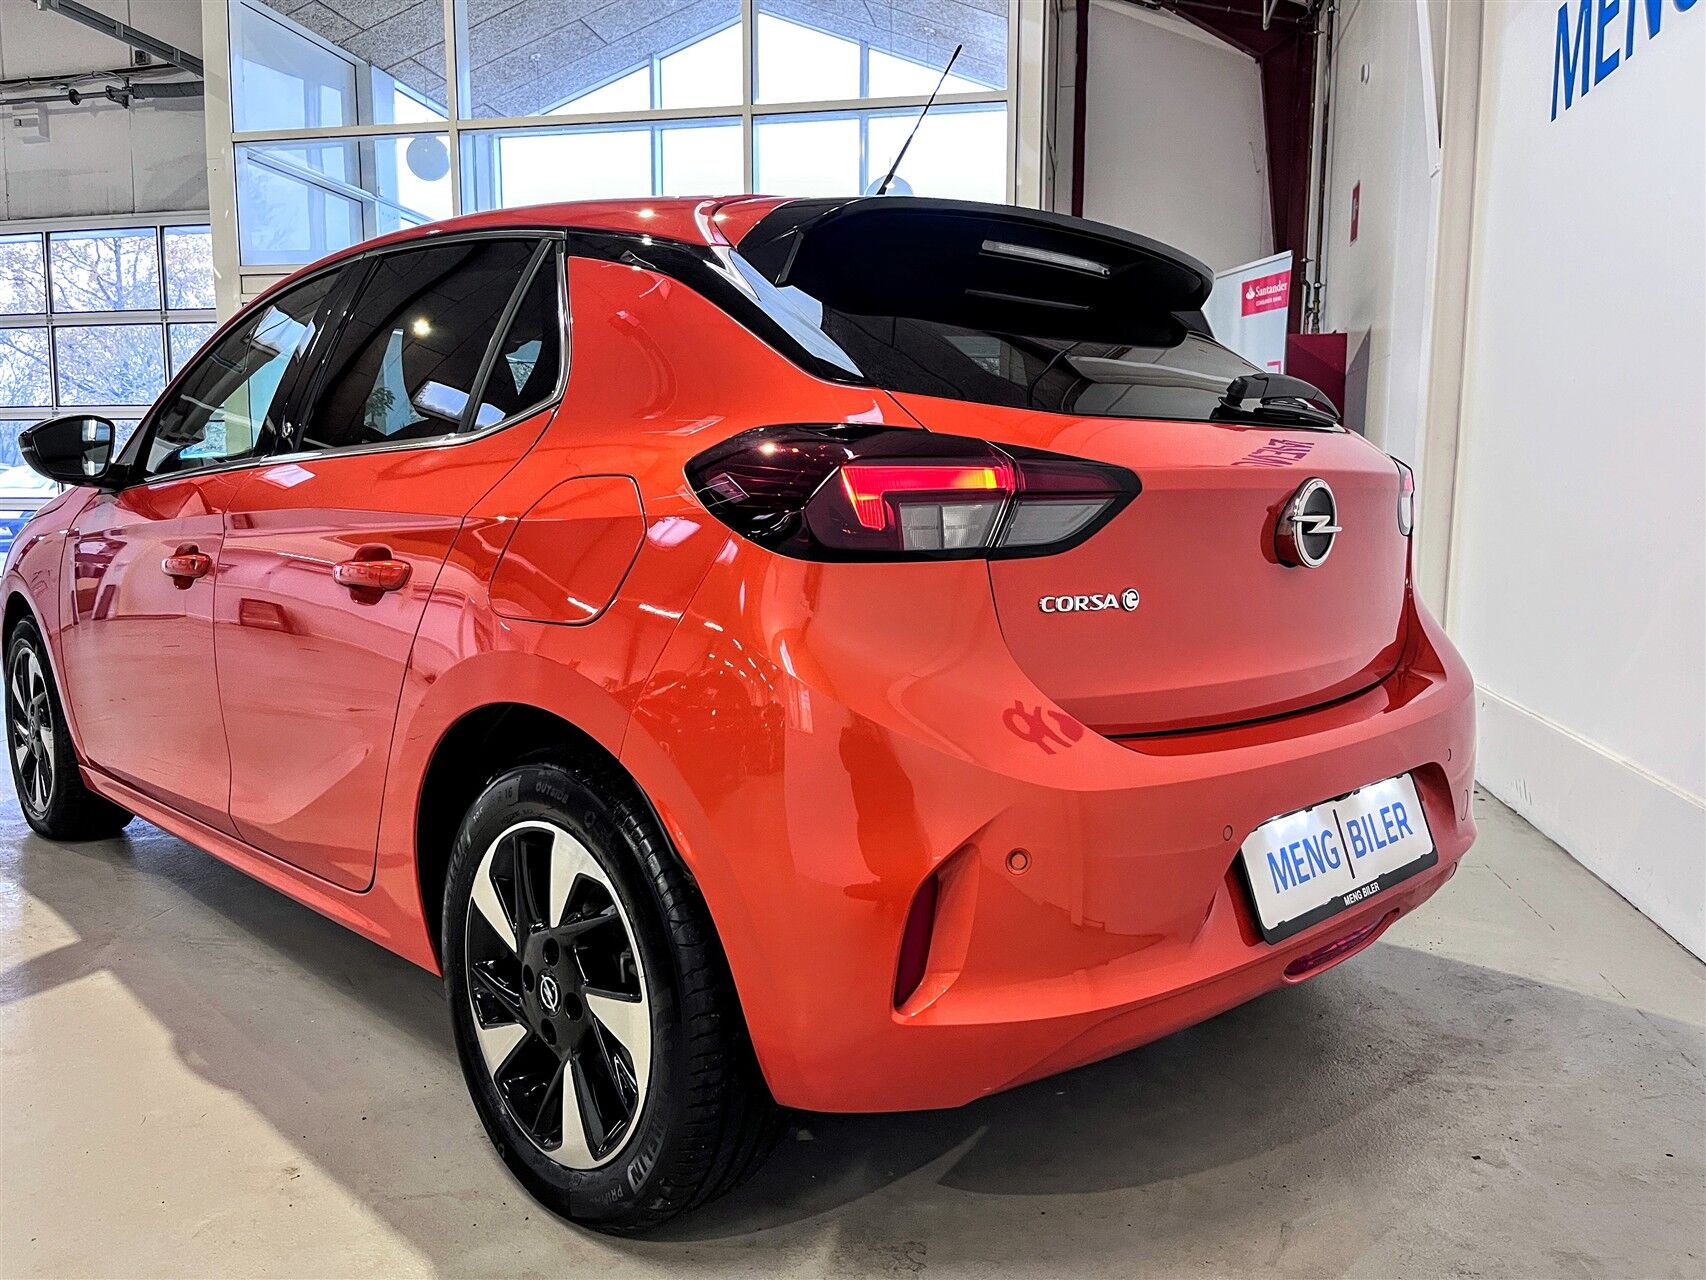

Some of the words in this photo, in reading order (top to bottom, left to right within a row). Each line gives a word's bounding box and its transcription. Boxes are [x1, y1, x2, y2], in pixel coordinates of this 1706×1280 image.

[1551, 0, 1698, 122] ME
[1255, 280, 1287, 297] Santander
[1040, 593, 1119, 613] CORSA
[1266, 829, 1341, 894] MENG
[1346, 801, 1414, 859] BILER
[1343, 889, 1363, 906] MENG
[1362, 881, 1380, 898] BILER
